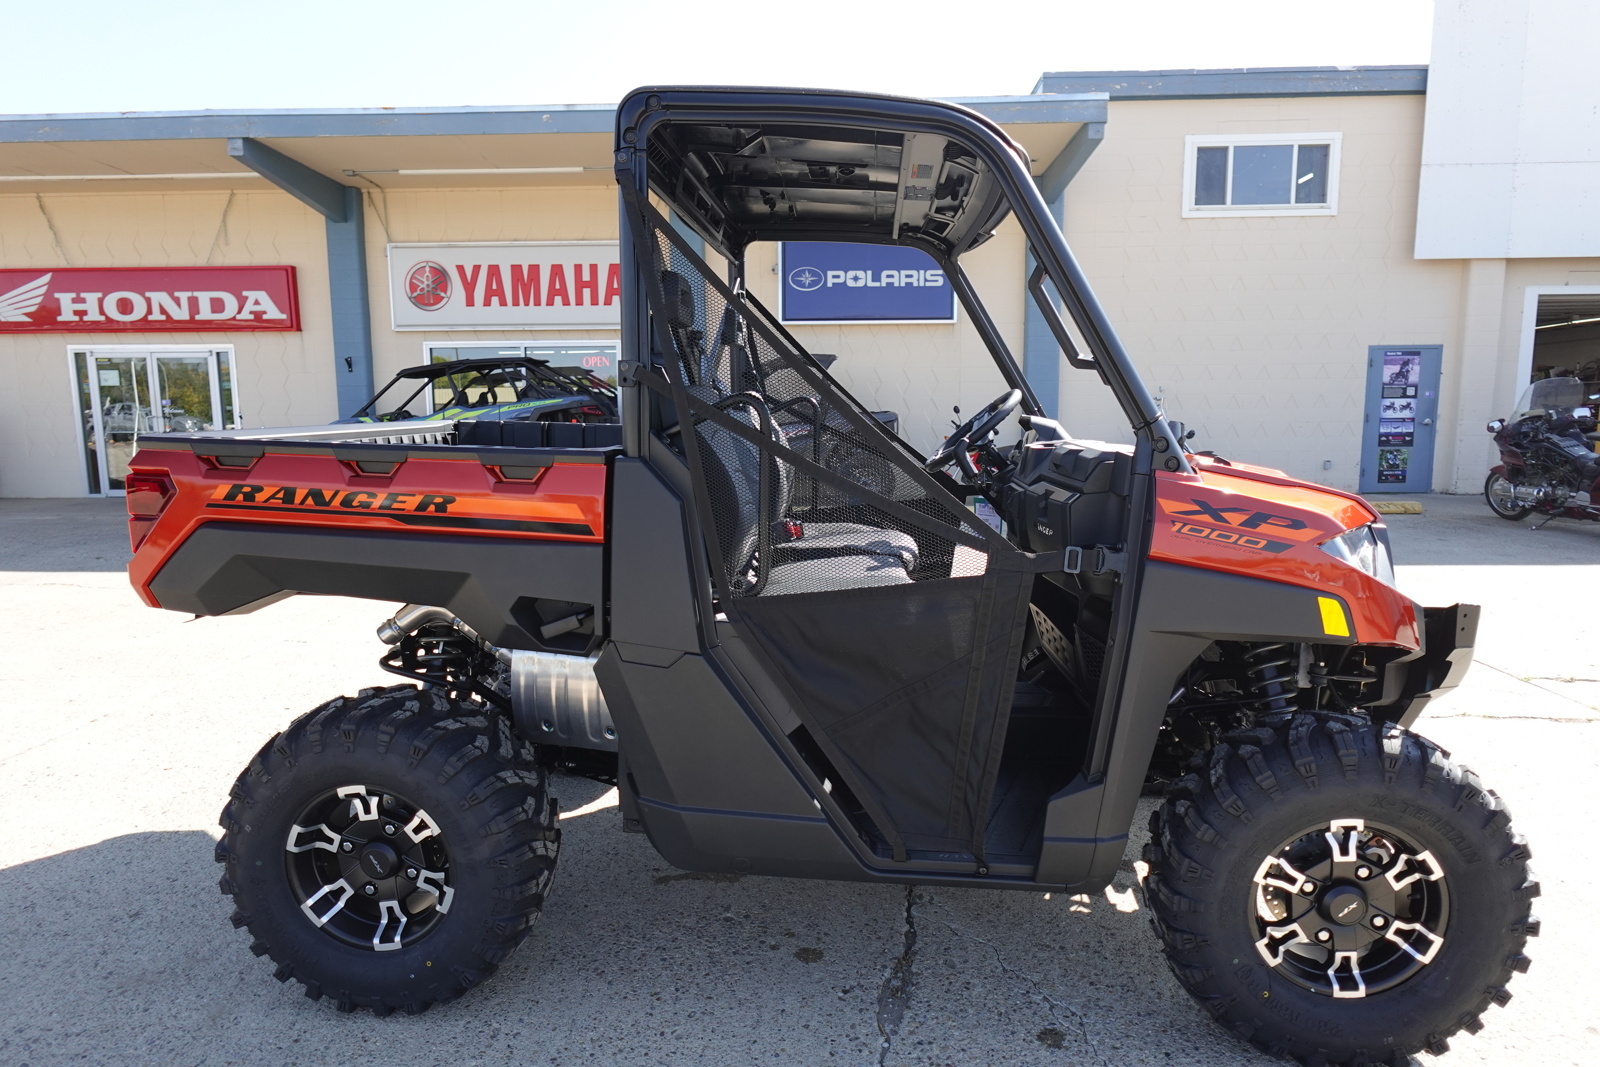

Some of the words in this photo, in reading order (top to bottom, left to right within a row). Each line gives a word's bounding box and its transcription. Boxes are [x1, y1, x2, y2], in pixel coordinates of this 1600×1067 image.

[455, 264, 621, 307] YAMAHA
[826, 269, 944, 288] POLARIS
[54, 290, 287, 322] HONDA
[582, 356, 610, 368] OPEN
[221, 483, 457, 514] RANGER
[1170, 498, 1309, 531] XP
[1170, 522, 1268, 549] 1000
[1170, 534, 1193, 543] DUAL
[1195, 540, 1242, 551] OVERHEAD
[1367, 793, 1482, 865] X-TERRAIN
